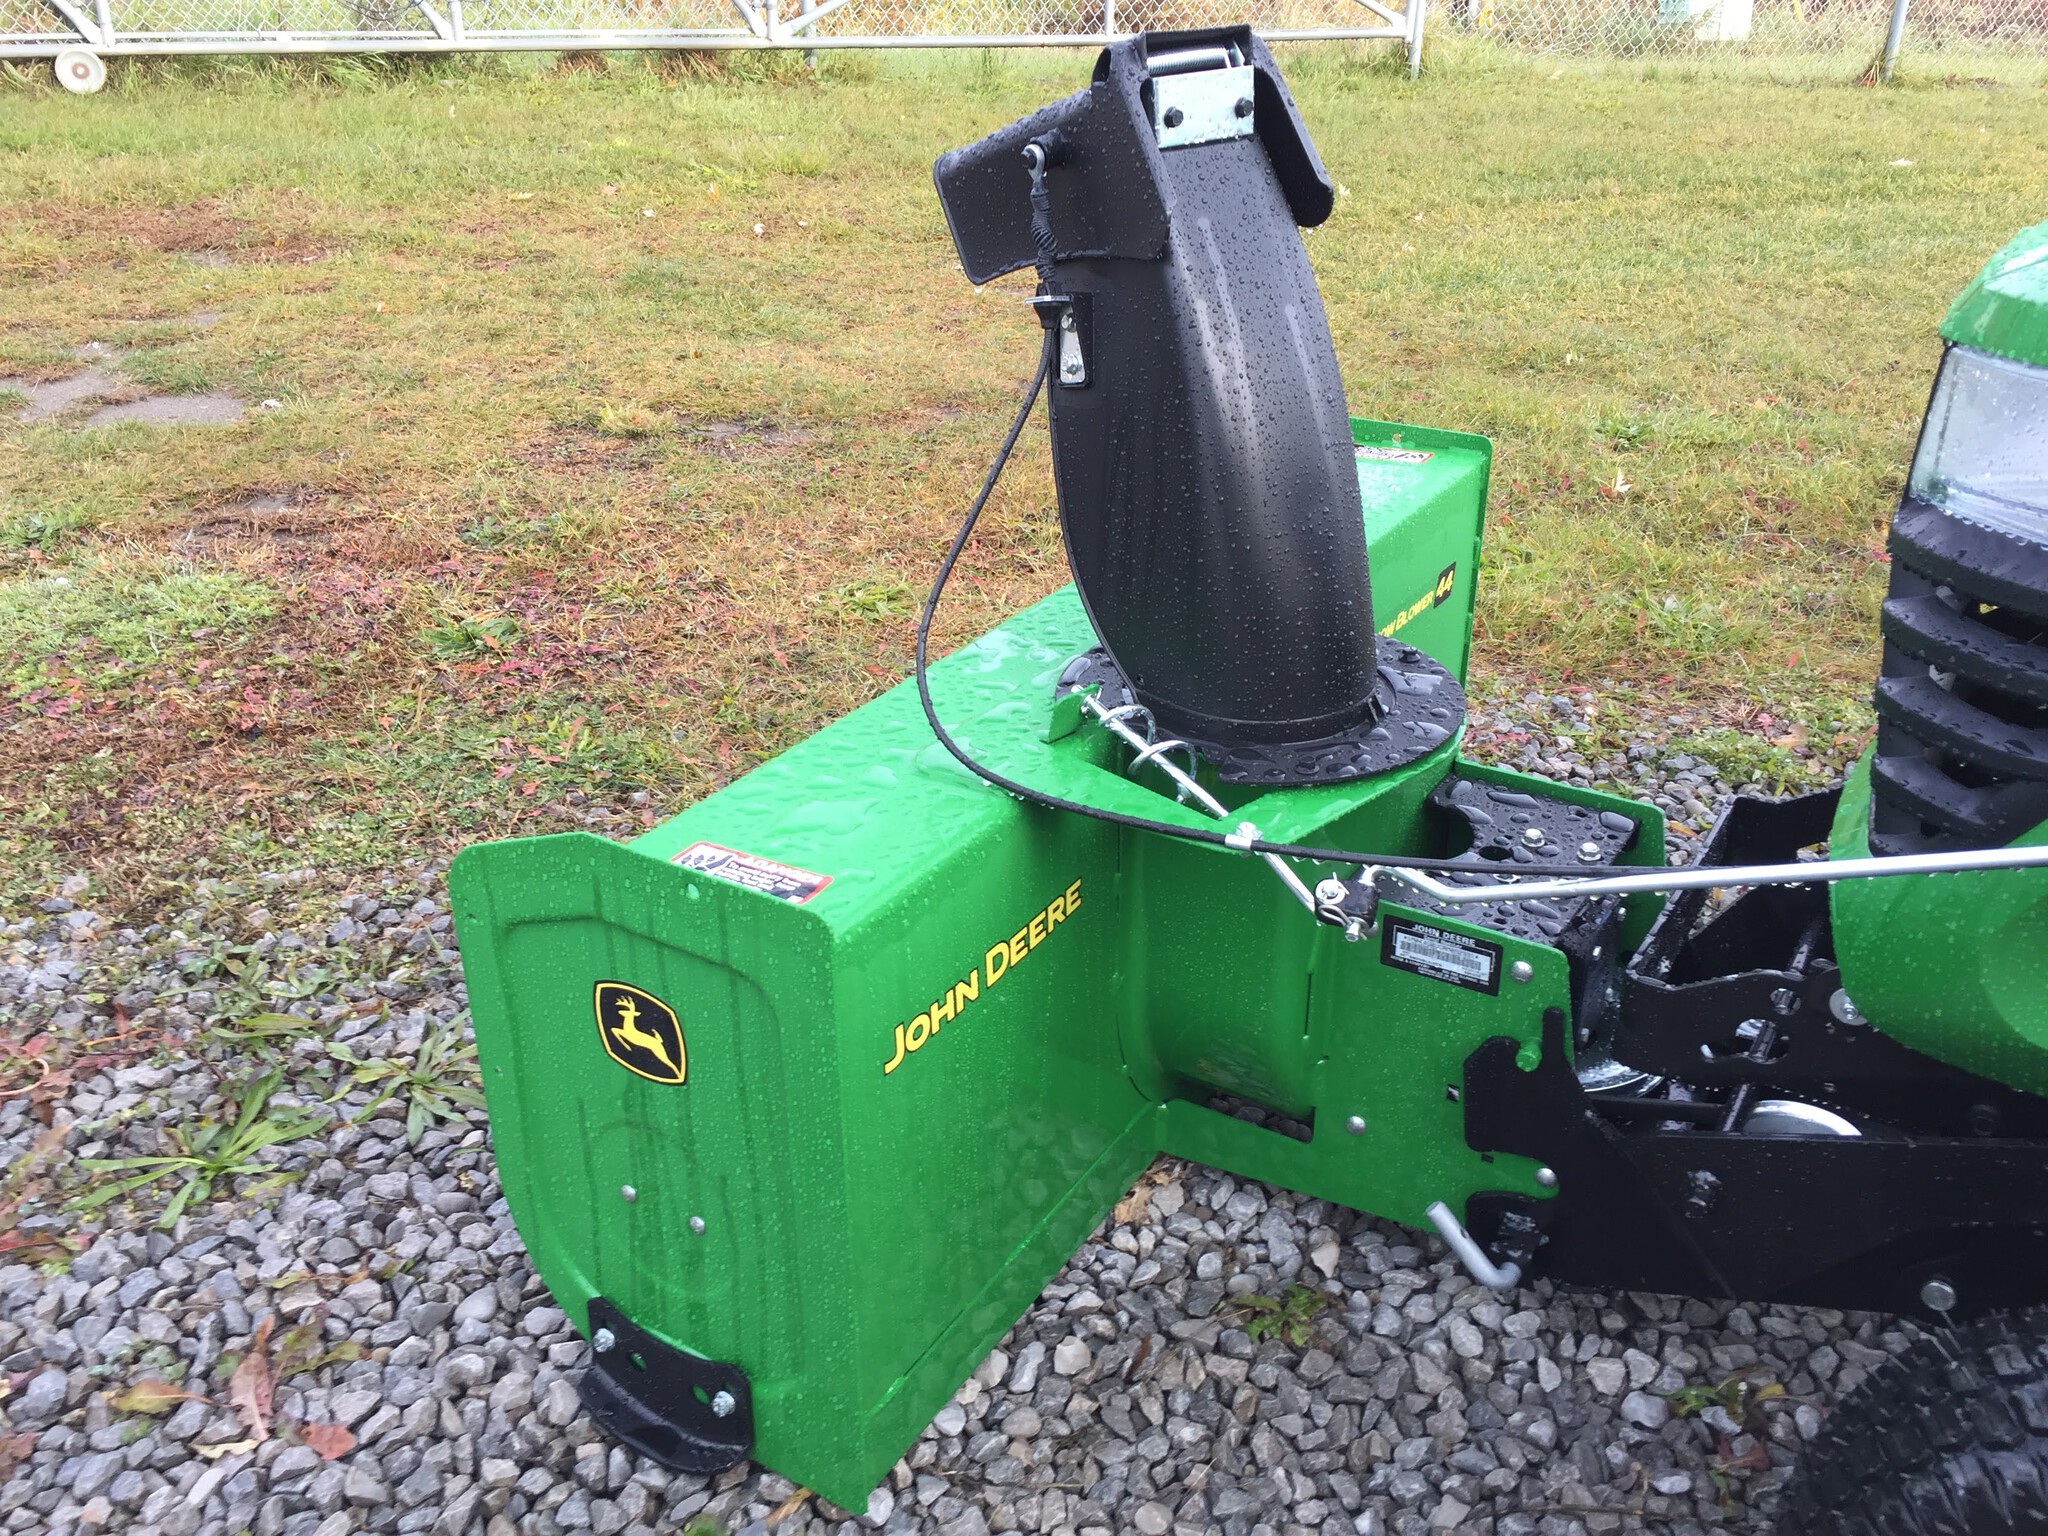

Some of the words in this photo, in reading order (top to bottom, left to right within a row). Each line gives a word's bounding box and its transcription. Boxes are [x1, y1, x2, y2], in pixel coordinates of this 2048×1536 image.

[1378, 619, 1397, 638] OW
[1395, 590, 1435, 631] BLOWER
[1436, 569, 1454, 598] 44
[1412, 924, 1440, 938] JOHN
[1442, 930, 1476, 946] DEERE
[884, 967, 980, 1076] JOHN
[985, 876, 1082, 989] DEERE
